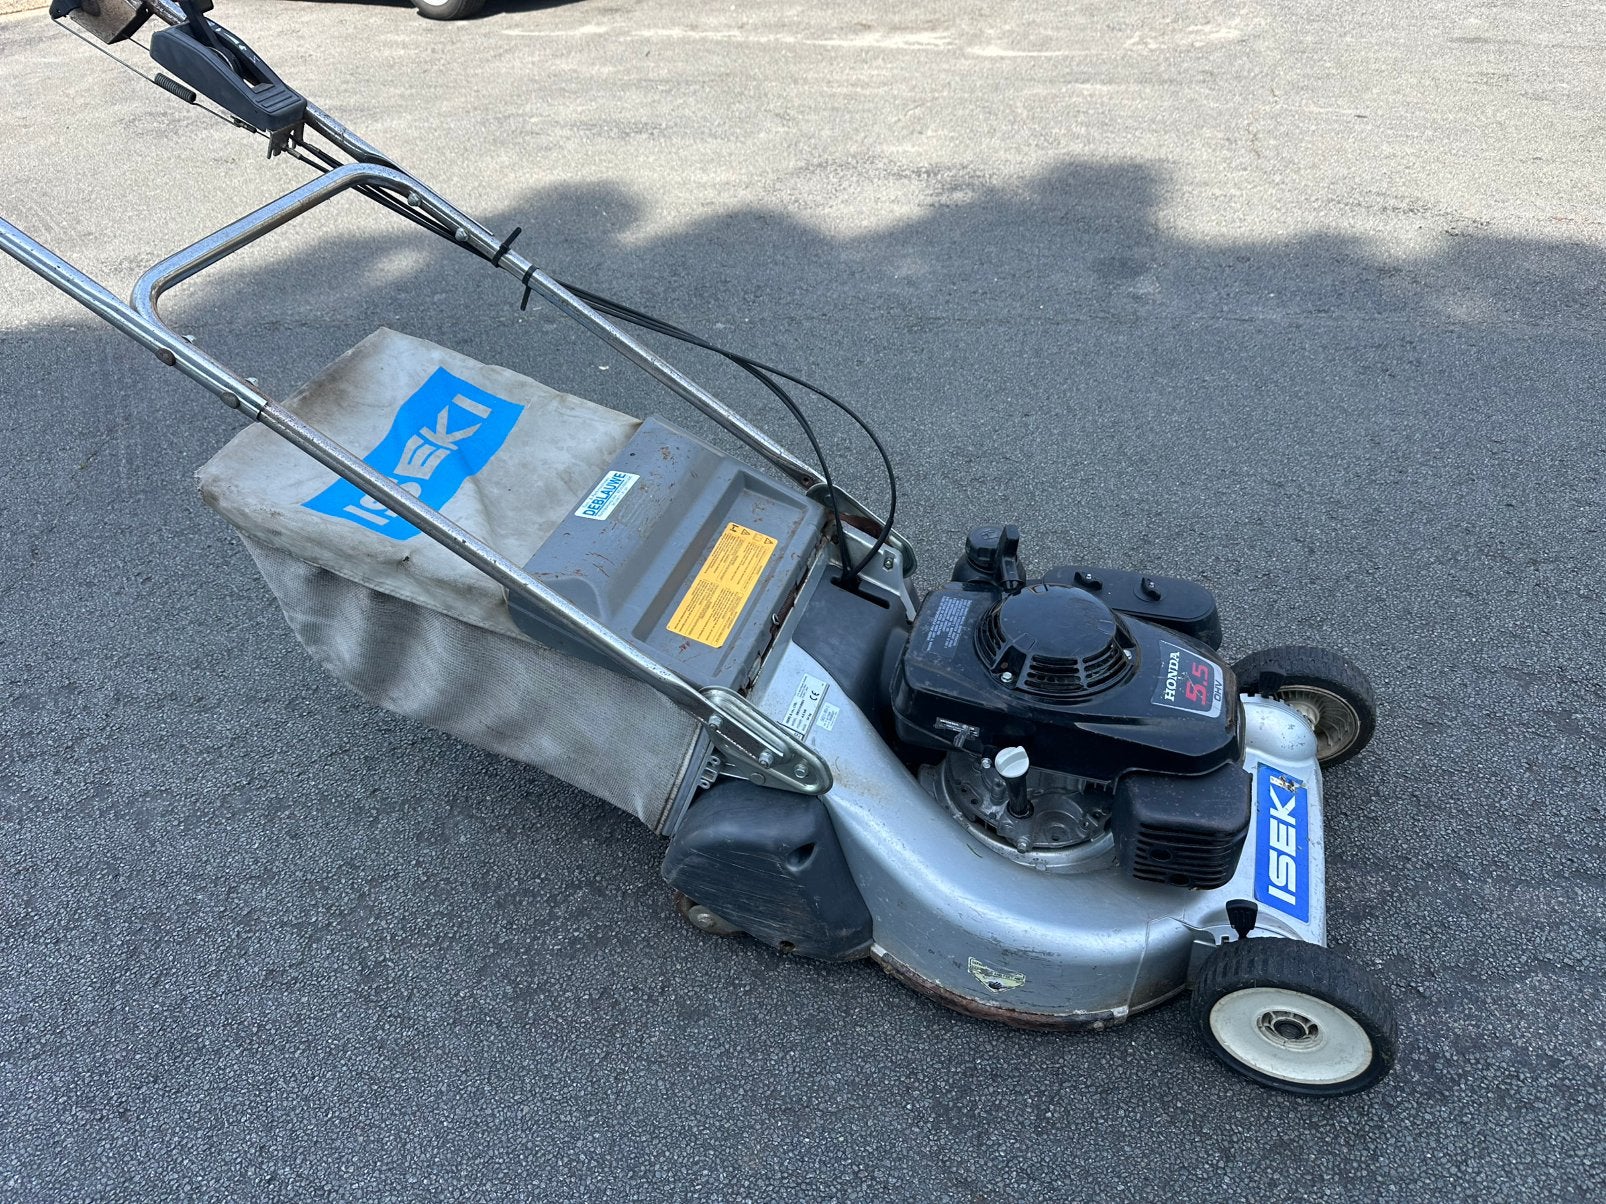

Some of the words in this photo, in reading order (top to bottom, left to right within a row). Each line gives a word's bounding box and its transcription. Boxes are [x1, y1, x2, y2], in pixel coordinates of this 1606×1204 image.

[582, 472, 626, 516] DEBLAUWE
[1164, 651, 1180, 702] HONDA
[1185, 662, 1209, 705] 5.5
[1213, 680, 1223, 702] OHV
[1268, 775, 1296, 905] ISEKI
